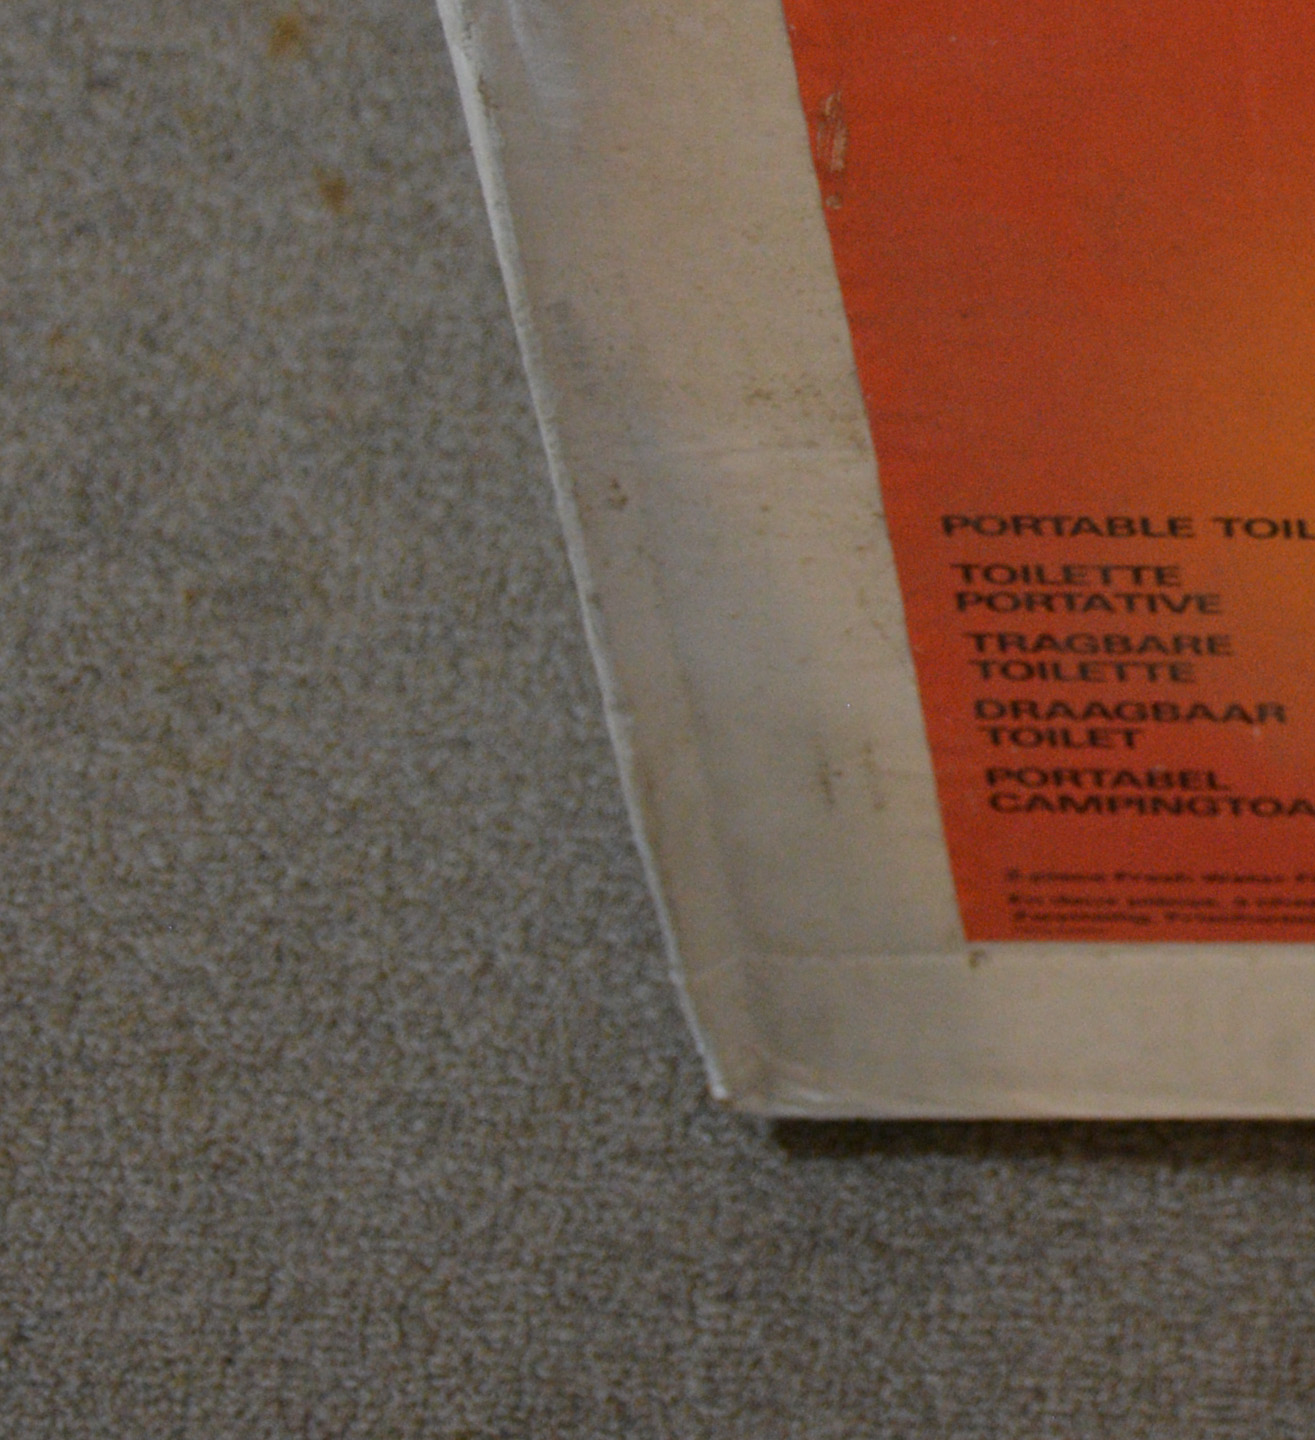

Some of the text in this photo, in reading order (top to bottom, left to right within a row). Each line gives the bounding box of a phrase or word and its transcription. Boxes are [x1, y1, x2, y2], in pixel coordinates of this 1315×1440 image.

[941, 514, 1195, 539] PORTABLE
[950, 563, 1183, 588] TOILETTE
[954, 591, 1223, 615] PORTATIVE
[964, 632, 1234, 657] TRAGBARE
[969, 659, 1197, 684] TOILETTE
[973, 699, 1288, 725] DRAAGBAAR
[979, 726, 1144, 751] TOILET
[985, 767, 1231, 792] PORTABEL
